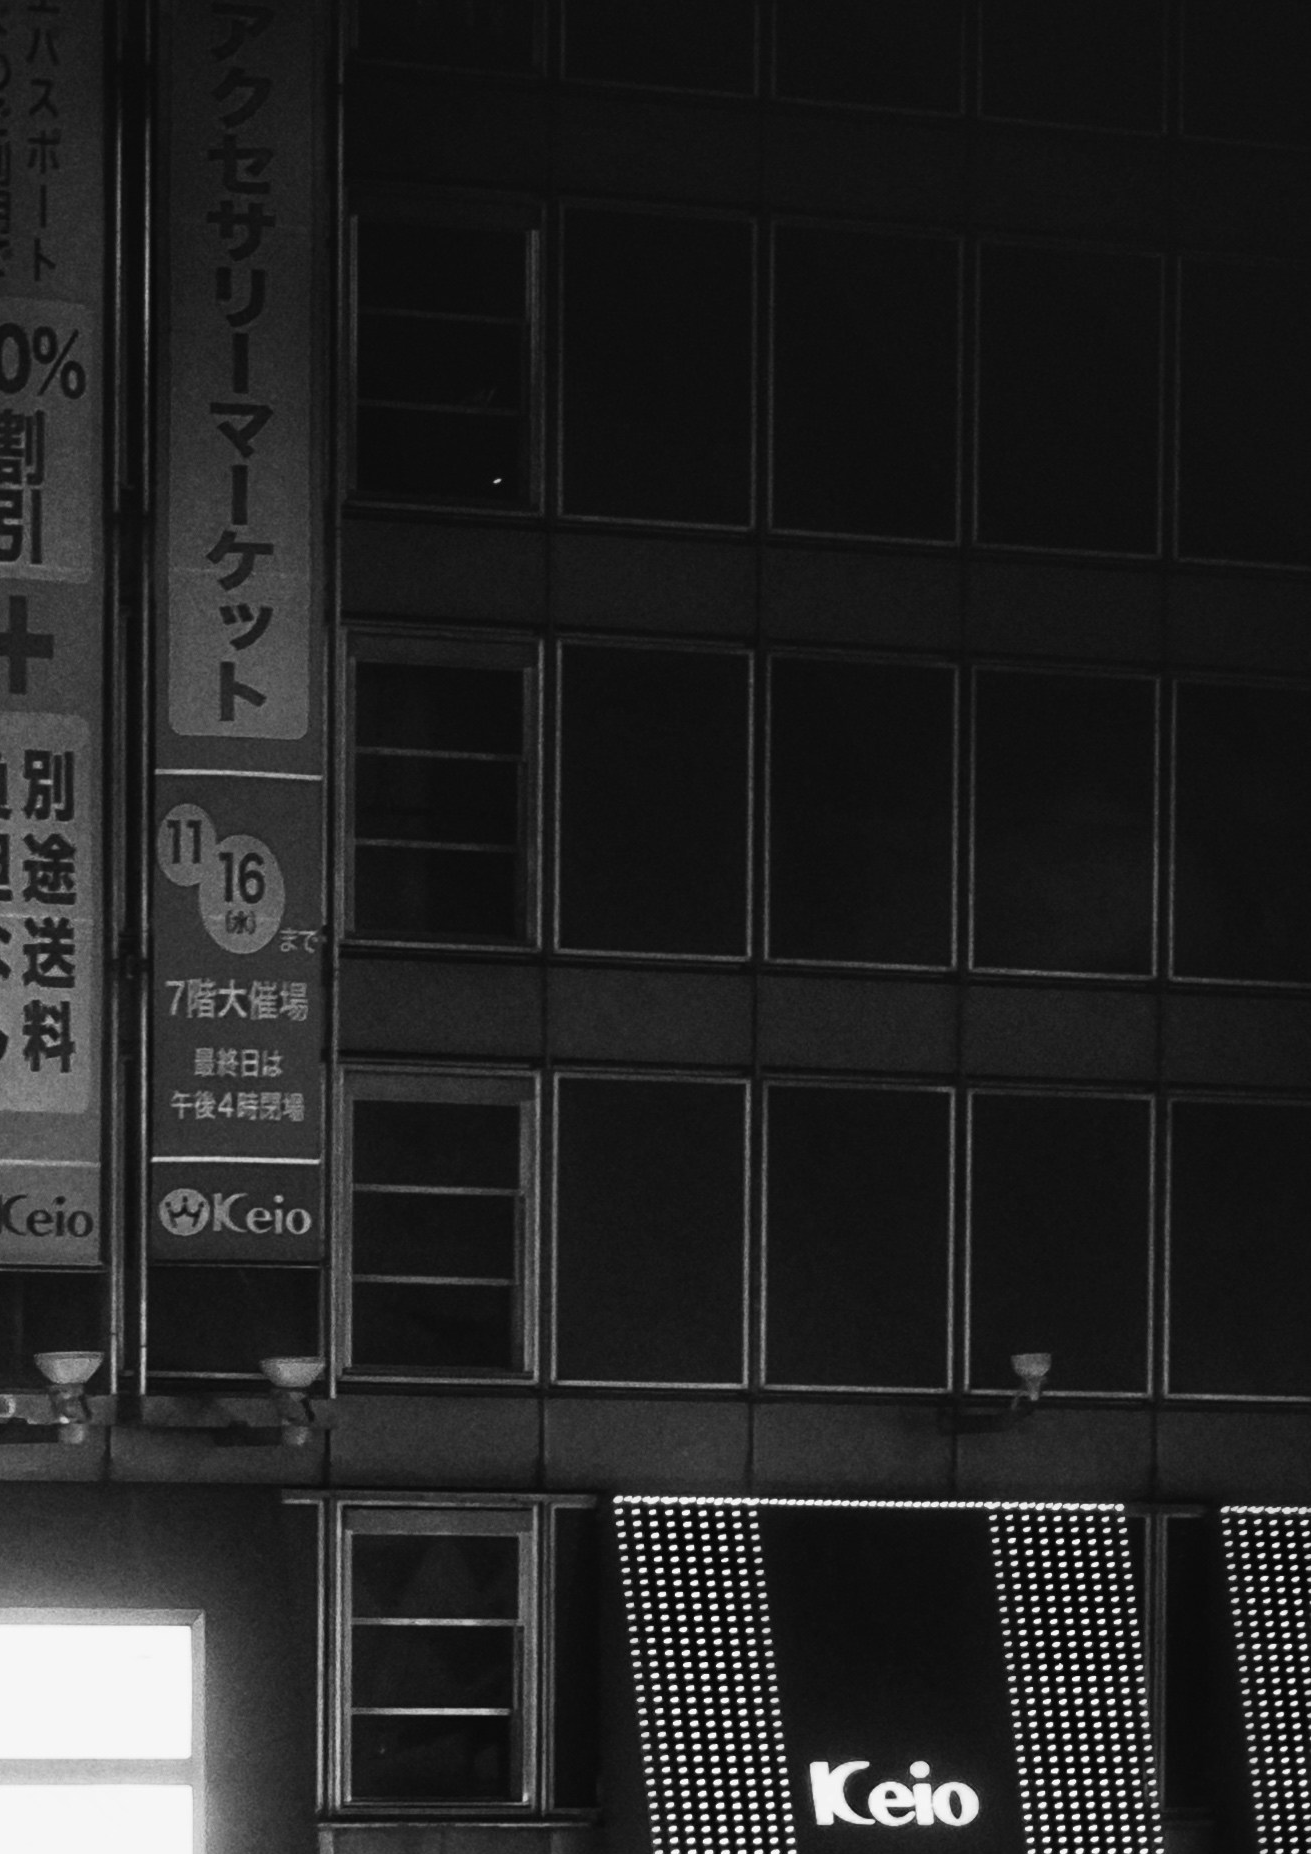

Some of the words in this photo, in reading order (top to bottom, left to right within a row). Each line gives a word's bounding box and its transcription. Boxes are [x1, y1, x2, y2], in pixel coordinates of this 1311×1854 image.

[205, 2, 276, 722] アクセサリーマーケット
[165, 819, 203, 865] 11
[218, 851, 266, 905] 16
[22, 748, 77, 1074] 別途送料
[279, 928, 318, 955] まで
[165, 977, 309, 1022] 7階大催場
[193, 1047, 284, 1080] 最終日は
[212, 1193, 313, 1236] Keio
[809, 1759, 981, 1827] Keio
